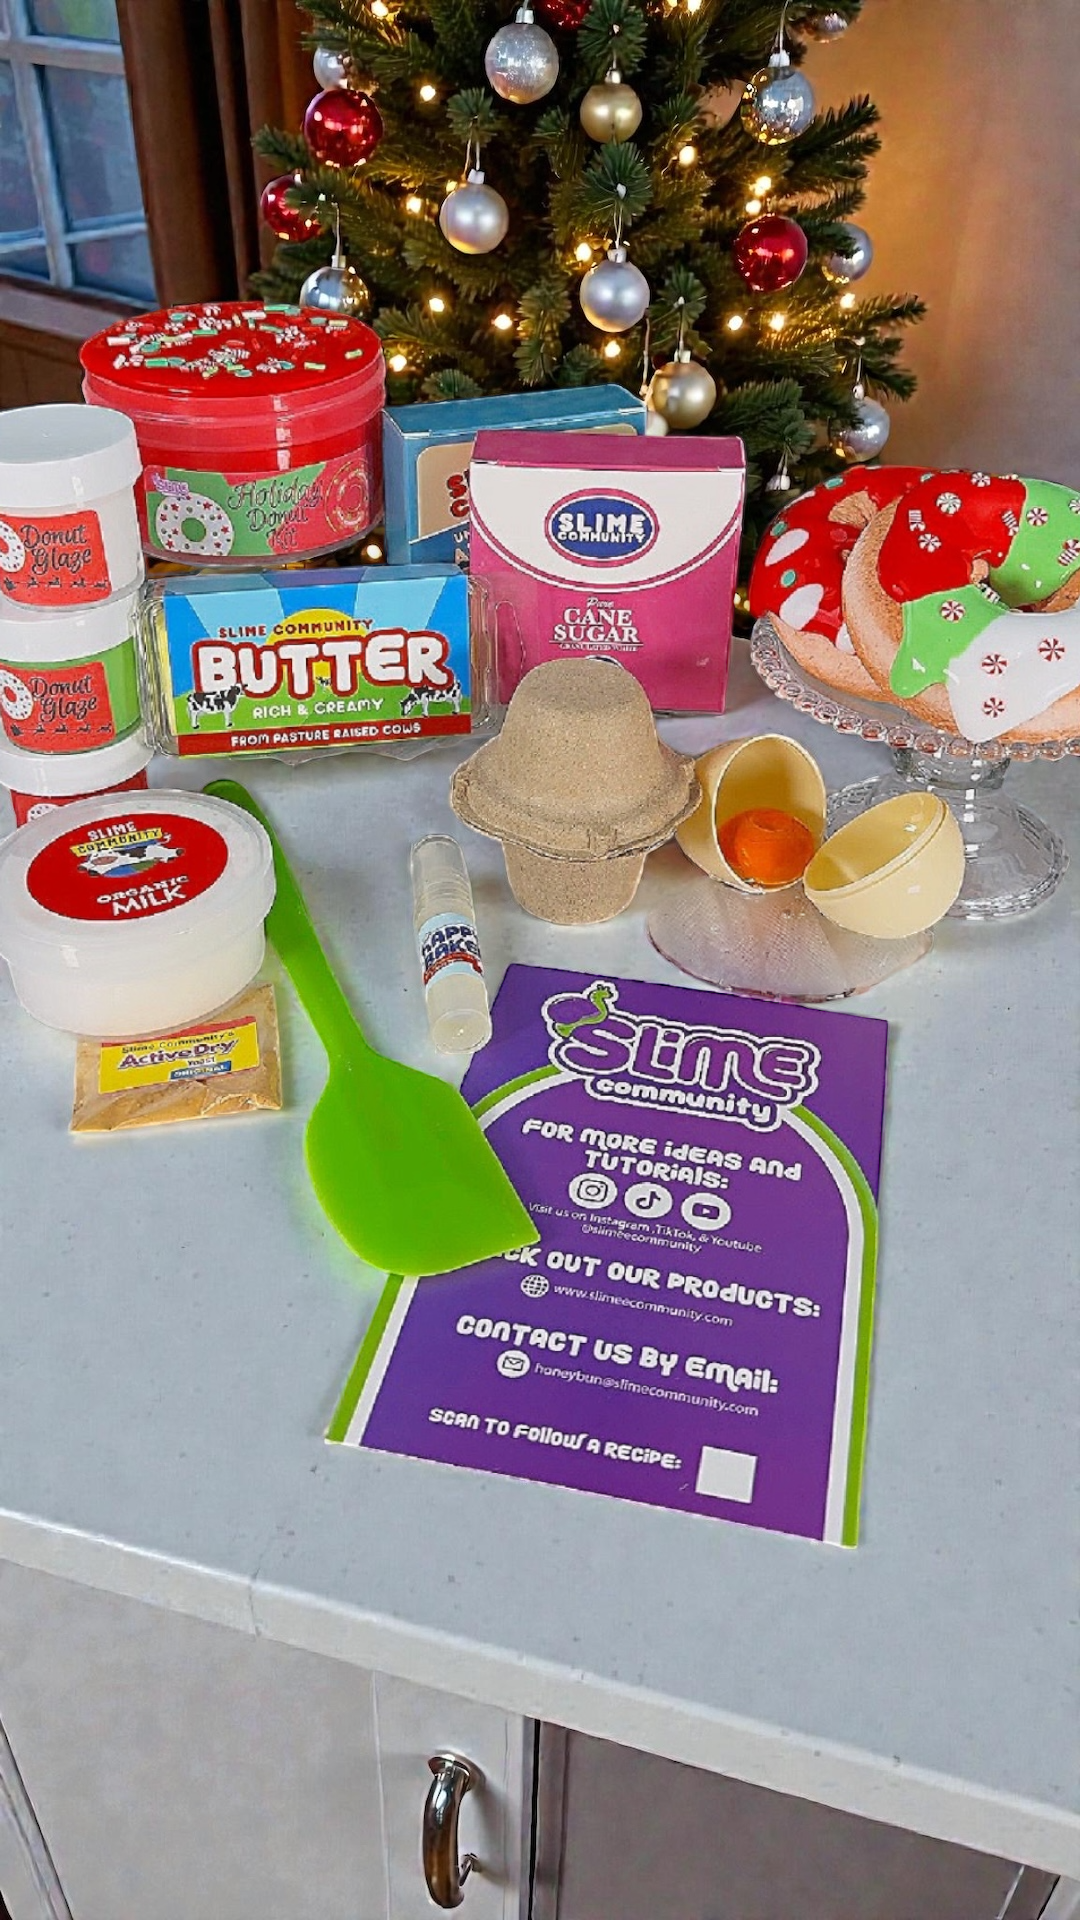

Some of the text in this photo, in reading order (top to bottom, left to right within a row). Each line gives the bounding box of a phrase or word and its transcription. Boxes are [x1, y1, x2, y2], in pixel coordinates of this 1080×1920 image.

[228, 476, 323, 510] Holiday
[246, 505, 309, 533] Donut
[557, 513, 646, 533] SLIME
[20, 524, 87, 549] Donut
[266, 526, 298, 549] Kit
[556, 531, 646, 543] COMMUNITY
[31, 547, 91, 575] Glaze
[218, 619, 374, 639] SLIME COMMUNITY
[564, 608, 633, 626] CANE
[554, 624, 640, 642] SUGAR
[196, 631, 450, 697] BUTTER
[29, 675, 93, 699] Donut
[40, 696, 97, 722] Glaze
[252, 698, 384, 719] RICH & CREAMY
[231, 722, 421, 747] FROM PASTURE RAISED COWS
[77, 829, 160, 854] COMMUNITY
[87, 821, 137, 841] SLIME
[97, 876, 189, 904] ORGANIC
[112, 885, 187, 916] MILK
[595, 1078, 771, 1122] community
[522, 1118, 573, 1143] FOR
[529, 1202, 553, 1215] Visit
[555, 1209, 569, 1217] us
[571, 1212, 587, 1221] on
[589, 1213, 650, 1232] Instagram
[699, 1233, 709, 1243] &
[711, 1235, 763, 1253] Youtube
[546, 1251, 601, 1277] OUT
[607, 1262, 660, 1290] OUR
[554, 1285, 734, 1327] www.slimeecommunity.com
[593, 1343, 633, 1365] US
[534, 1362, 759, 1416] honeybun@slimecommunity.com
[484, 1418, 510, 1436] TO
[586, 1438, 601, 1454] A
